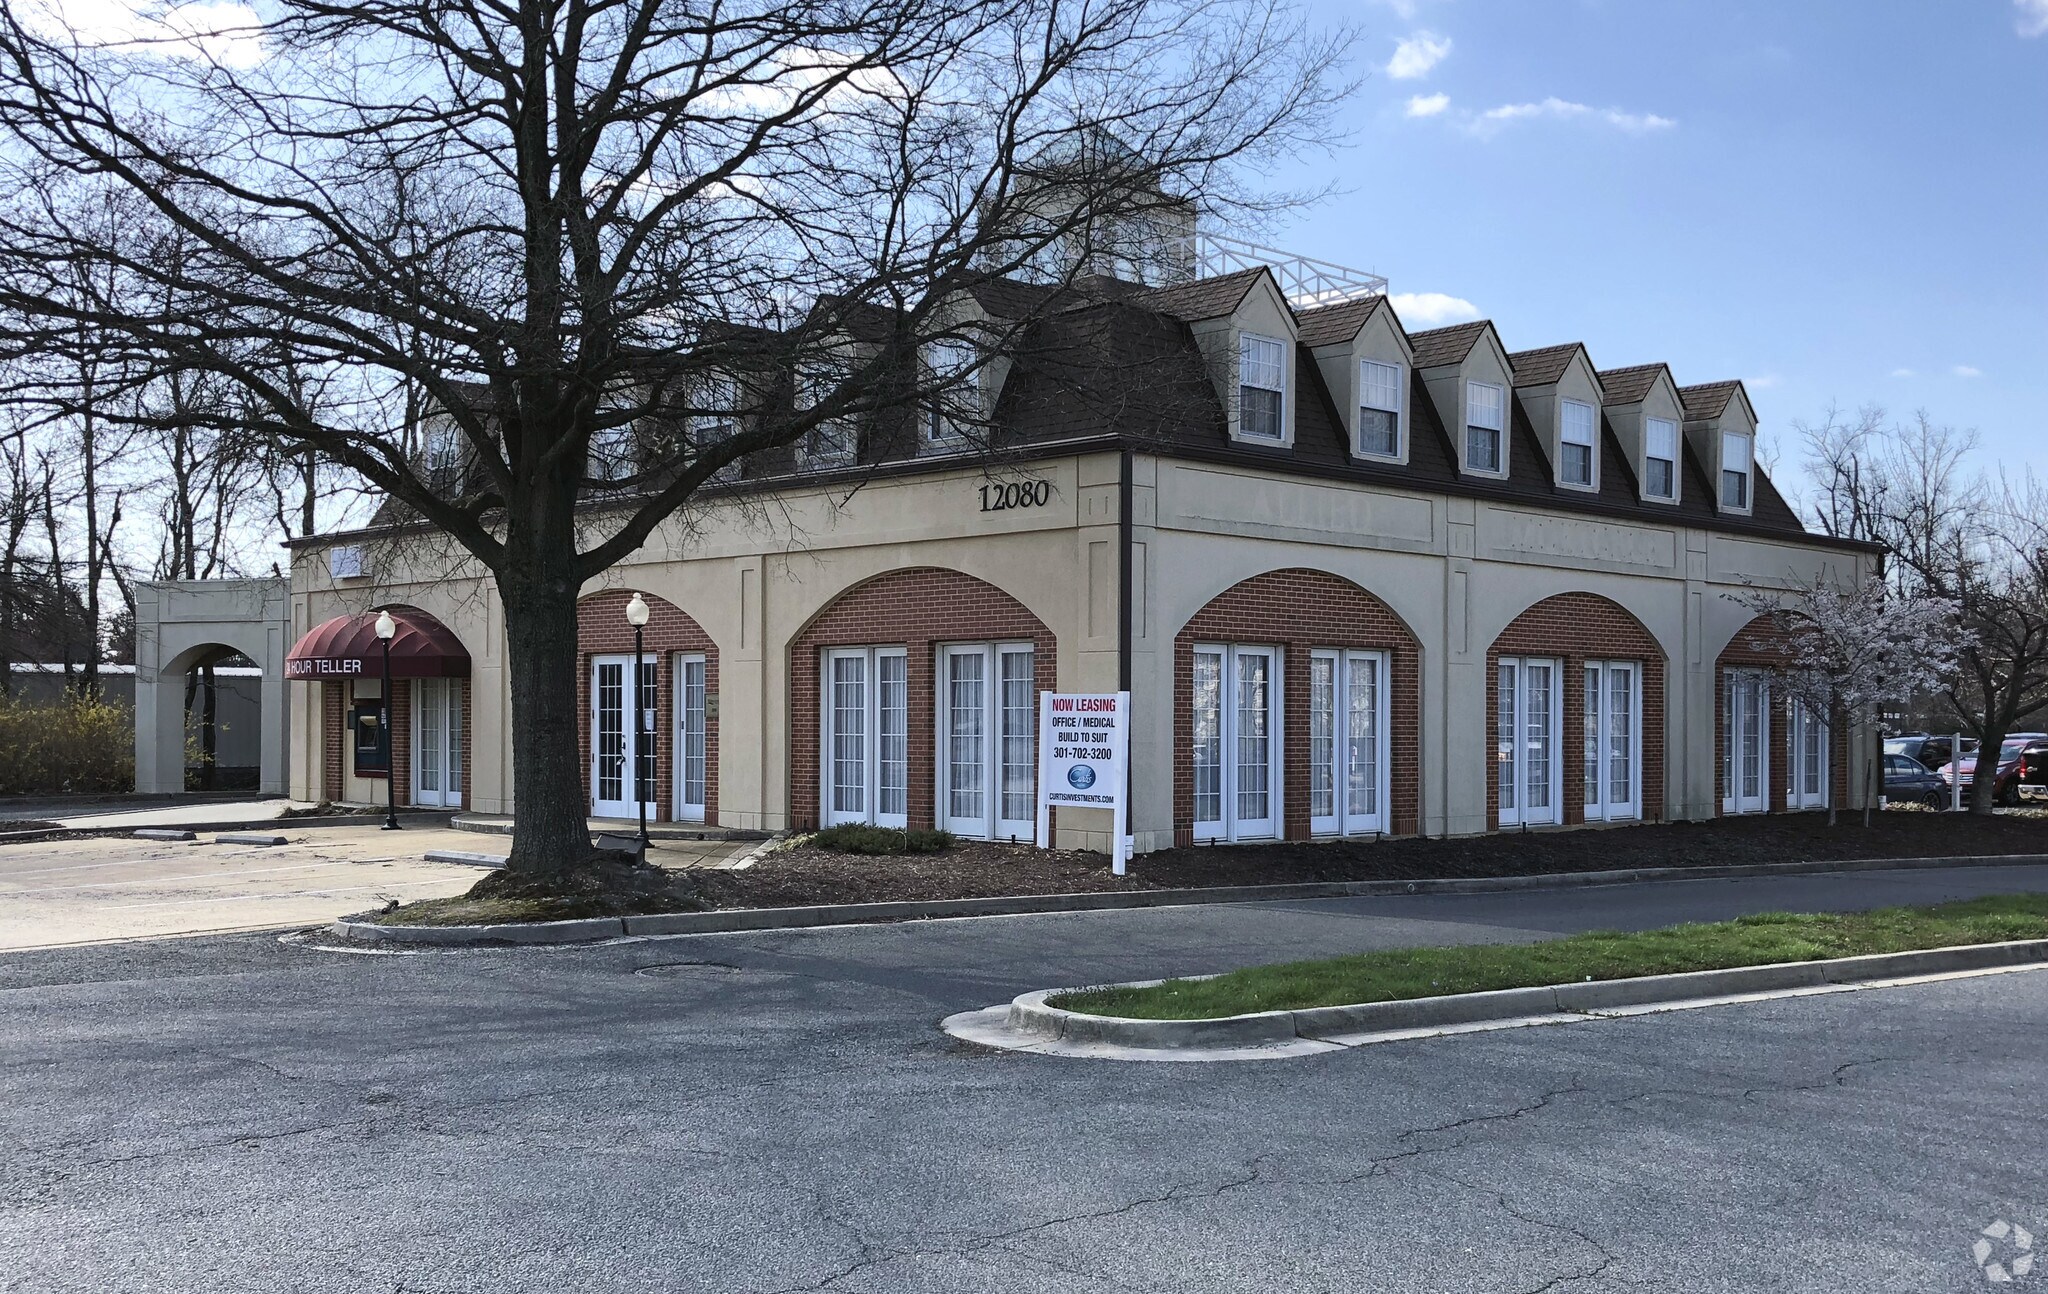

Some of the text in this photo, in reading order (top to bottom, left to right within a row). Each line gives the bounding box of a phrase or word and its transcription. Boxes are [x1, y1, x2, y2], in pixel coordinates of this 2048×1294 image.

[979, 480, 1049, 512] 12080
[291, 660, 312, 674] HOUR
[315, 659, 362, 673] TELLER
[1052, 698, 1116, 712] NOW LEASING
[1052, 716, 1077, 728] OFFICE
[1083, 717, 1116, 728] MEDICAL
[1058, 732, 1108, 743] BUILD TO SUIT
[1053, 746, 1112, 760] 301-702-3200
[1049, 793, 1114, 804] CURTISINVESTMENTS.COM
